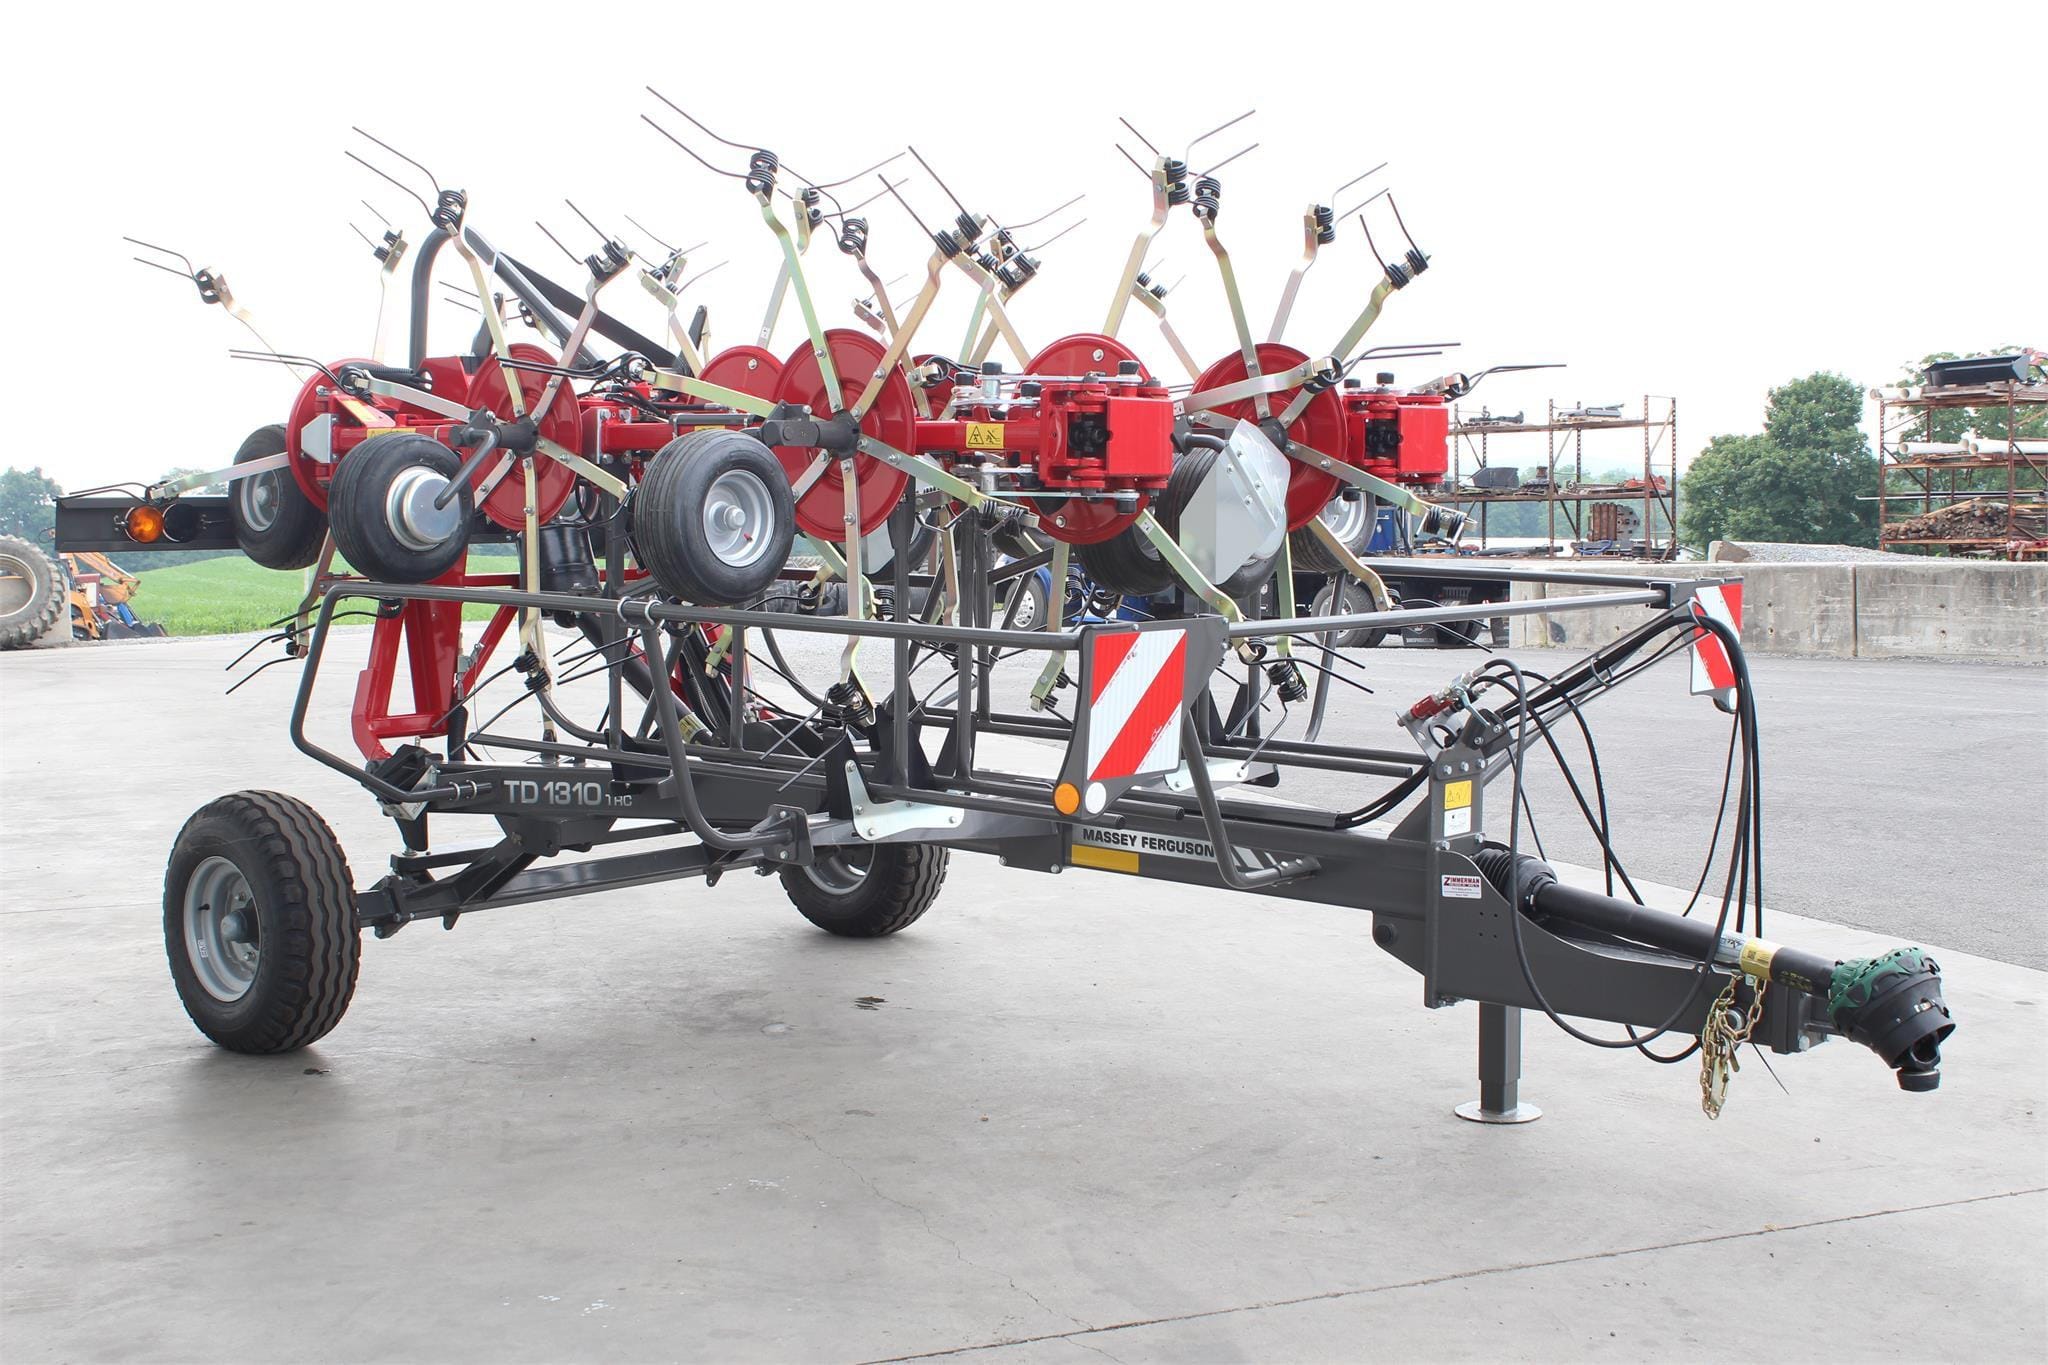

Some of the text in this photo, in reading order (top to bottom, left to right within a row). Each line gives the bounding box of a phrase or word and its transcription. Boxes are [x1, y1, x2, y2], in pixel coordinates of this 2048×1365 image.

[503, 780, 538, 803] TD
[543, 781, 602, 806] 1310
[1083, 828, 1215, 857] MASSEY FERGUSON
[1443, 877, 1480, 886] ZIMMERMAN
